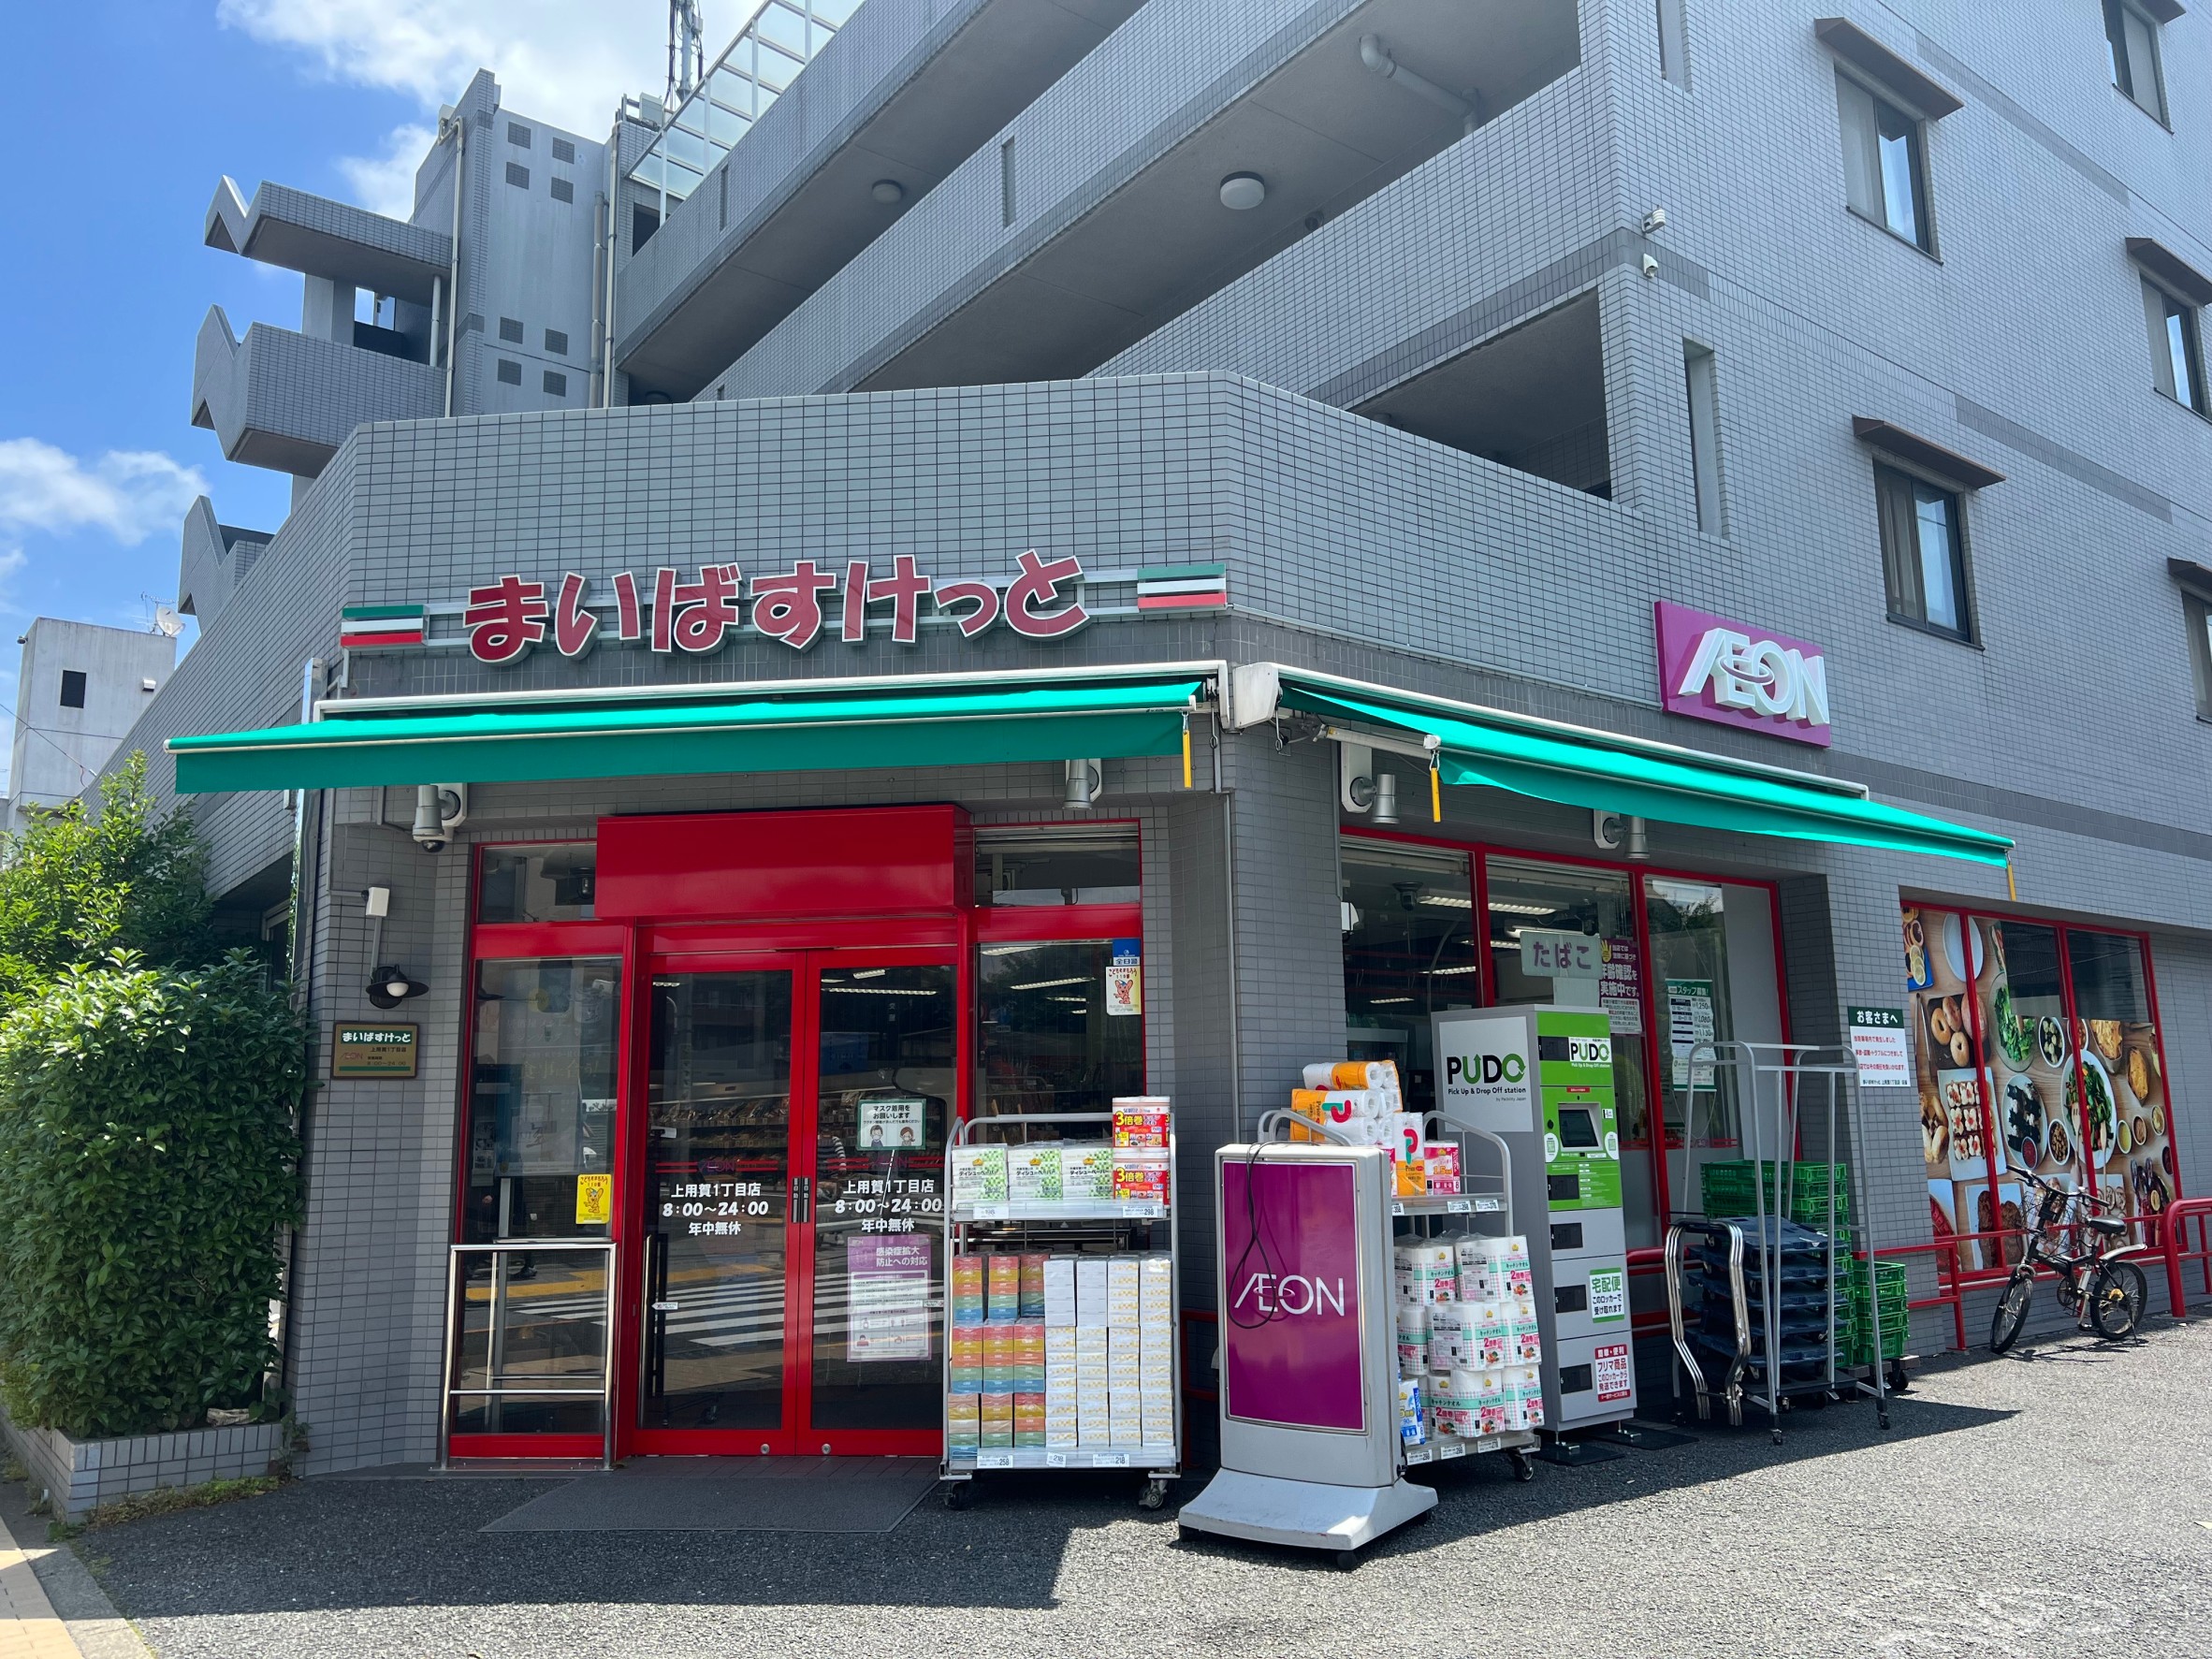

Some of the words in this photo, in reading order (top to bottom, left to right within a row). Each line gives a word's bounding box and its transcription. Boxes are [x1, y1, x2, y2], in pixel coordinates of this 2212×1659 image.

[465, 548, 1091, 663] まいばすけっと
[1534, 941, 1592, 969] たばこ
[1856, 1011, 1899, 1025] お客さまへ
[342, 1032, 412, 1043] まいばすけっと
[1571, 1042, 1609, 1061] PUDO
[1447, 1053, 1526, 1084] PUDO
[1477, 1087, 1491, 1096] Drop
[1115, 1111, 1143, 1127] 3倍巻
[1116, 1167, 1144, 1183] 3倍巻
[671, 1183, 761, 1198] 上用賀1丁目店
[843, 1179, 935, 1195] 上用賀1丁目店
[689, 1221, 741, 1235] 年中無休
[861, 1217, 915, 1233] 年中無休
[876, 1245, 920, 1257] 感染症拡大
[876, 1257, 928, 1268] 防止への対応
[1592, 1275, 1622, 1293] 宅配便
[1593, 1293, 1622, 1304] このロッカーで
[1594, 1304, 1623, 1316] 受け取れます
[1597, 1359, 1626, 1373] フリマ商品
[1598, 1371, 1627, 1382] このロッカーから
[1598, 1380, 1628, 1391] 発送できます
